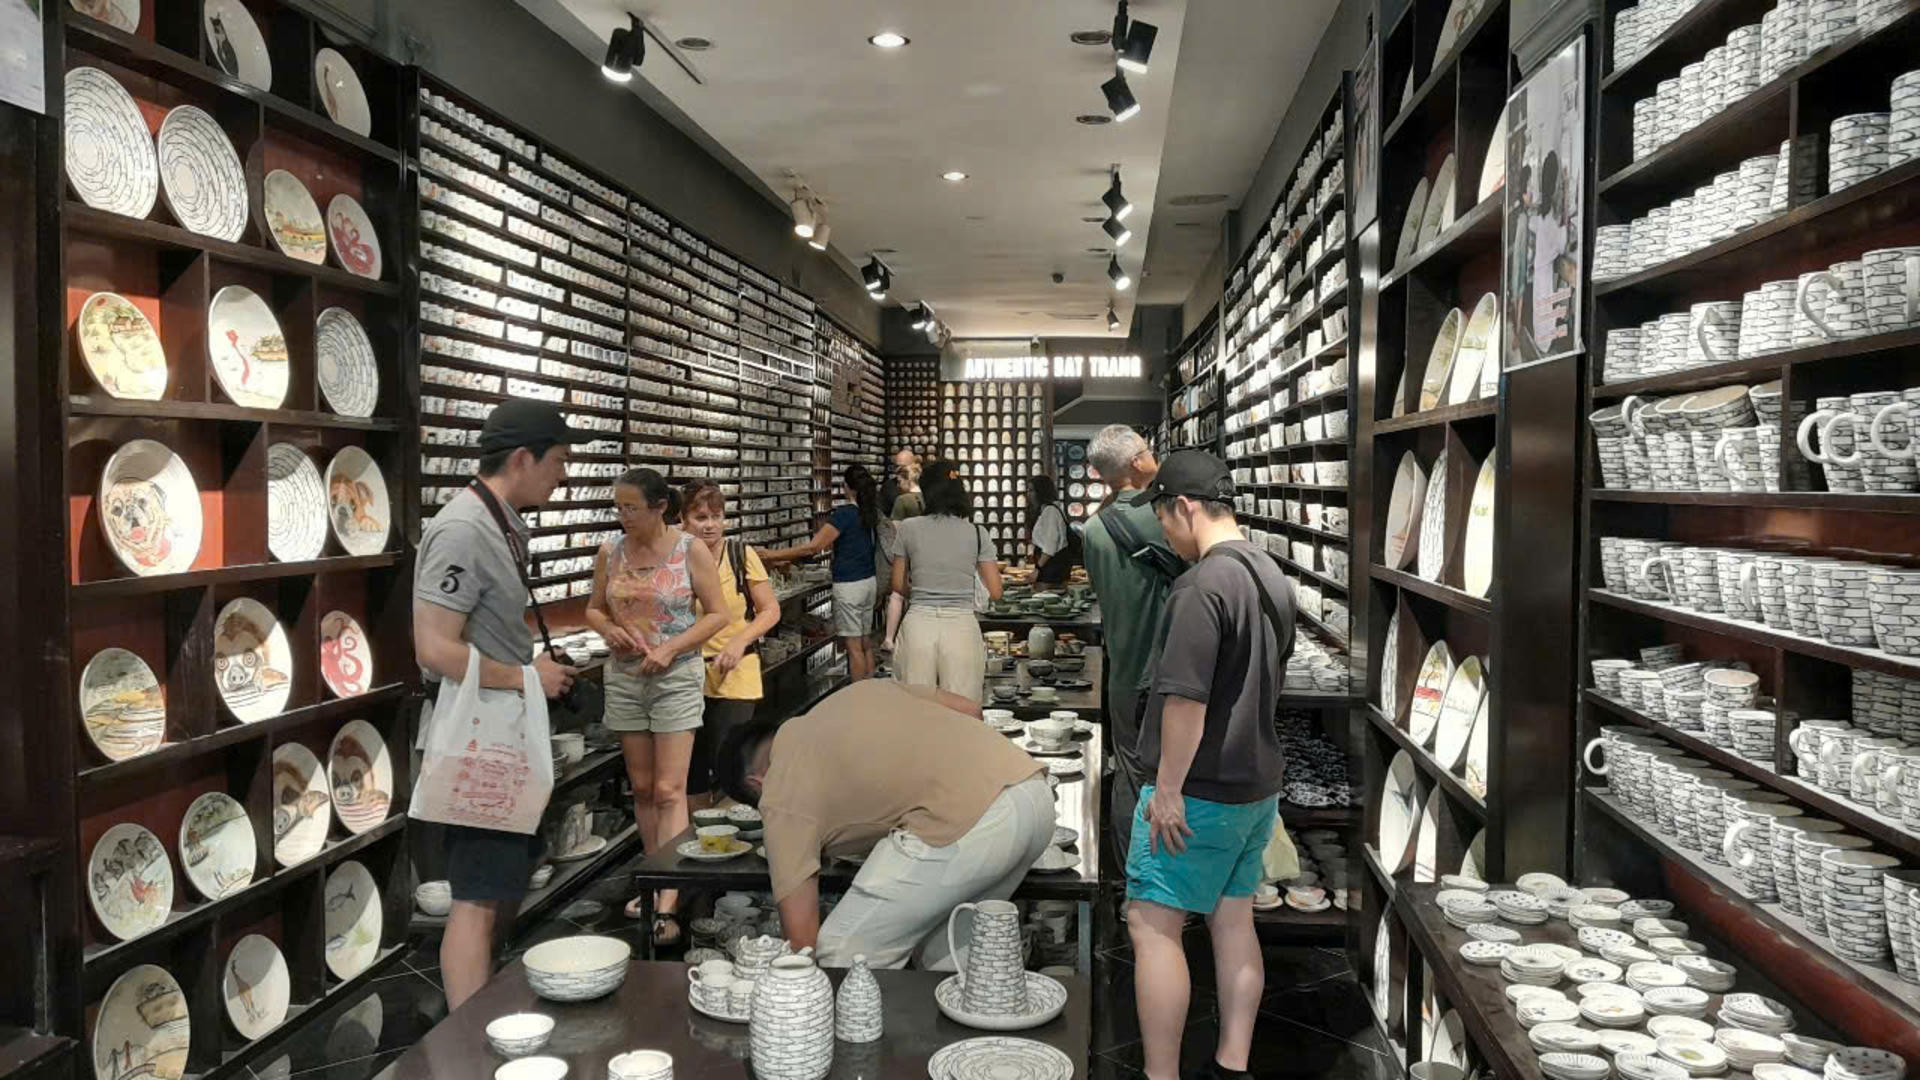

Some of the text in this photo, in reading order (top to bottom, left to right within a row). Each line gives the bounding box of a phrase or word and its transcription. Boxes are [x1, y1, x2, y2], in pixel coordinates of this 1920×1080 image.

[964, 356, 1141, 378] AUTHENTIC BAT TRANG
[440, 564, 465, 594] 3
